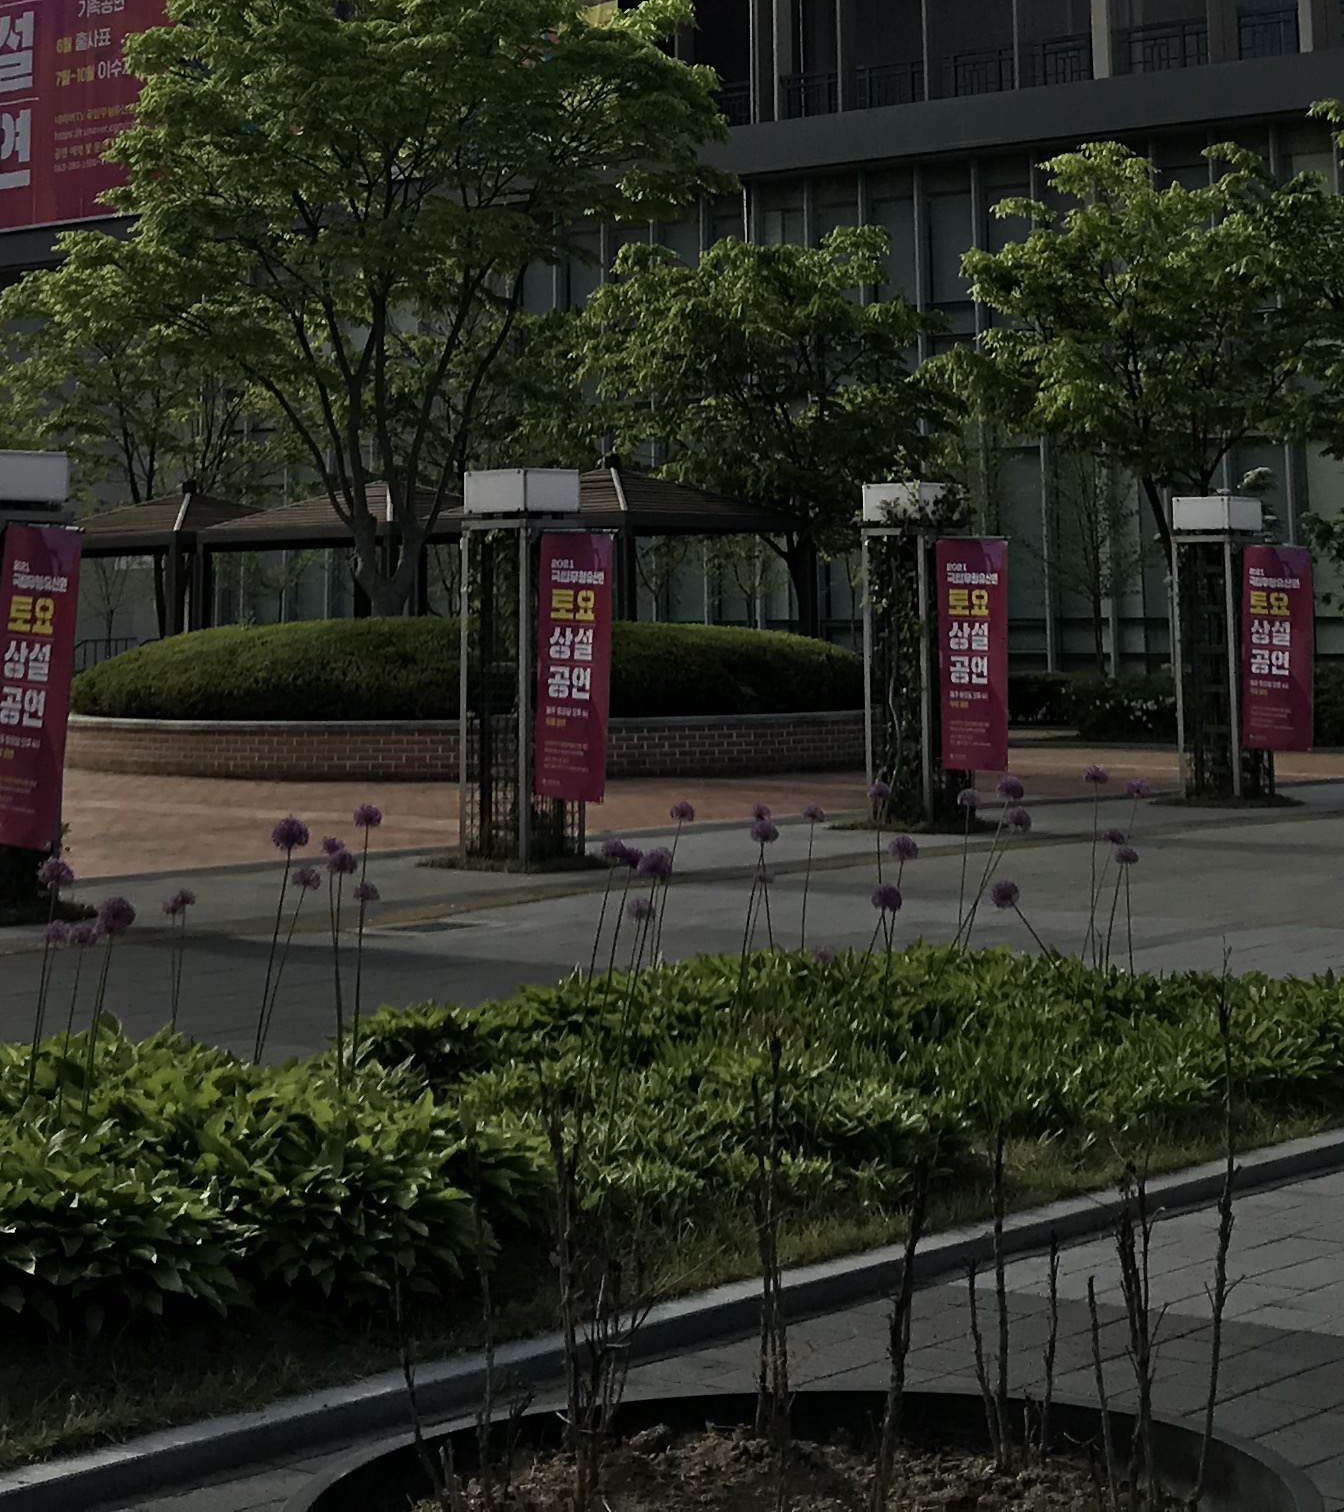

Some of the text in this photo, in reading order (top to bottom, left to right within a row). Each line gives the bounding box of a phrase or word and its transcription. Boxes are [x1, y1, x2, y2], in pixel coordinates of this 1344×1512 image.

[76, 28, 111, 52] 출사표
[13, 559, 30, 573] 2021
[551, 569, 605, 586] 국립무형유산원
[946, 572, 999, 586] 국립무형유산원
[7, 594, 55, 636] 토요
[550, 588, 596, 621] 토요
[947, 588, 990, 617] 토요
[1249, 591, 1290, 616] 토요
[549, 626, 594, 661] 상설
[948, 621, 989, 651] 상설
[1250, 620, 1290, 646] 상설
[3, 640, 52, 683] 상설
[949, 655, 988, 685] 공연
[1250, 649, 1289, 675] 공연
[548, 665, 591, 700] 공연
[0, 685, 46, 729] 공연
